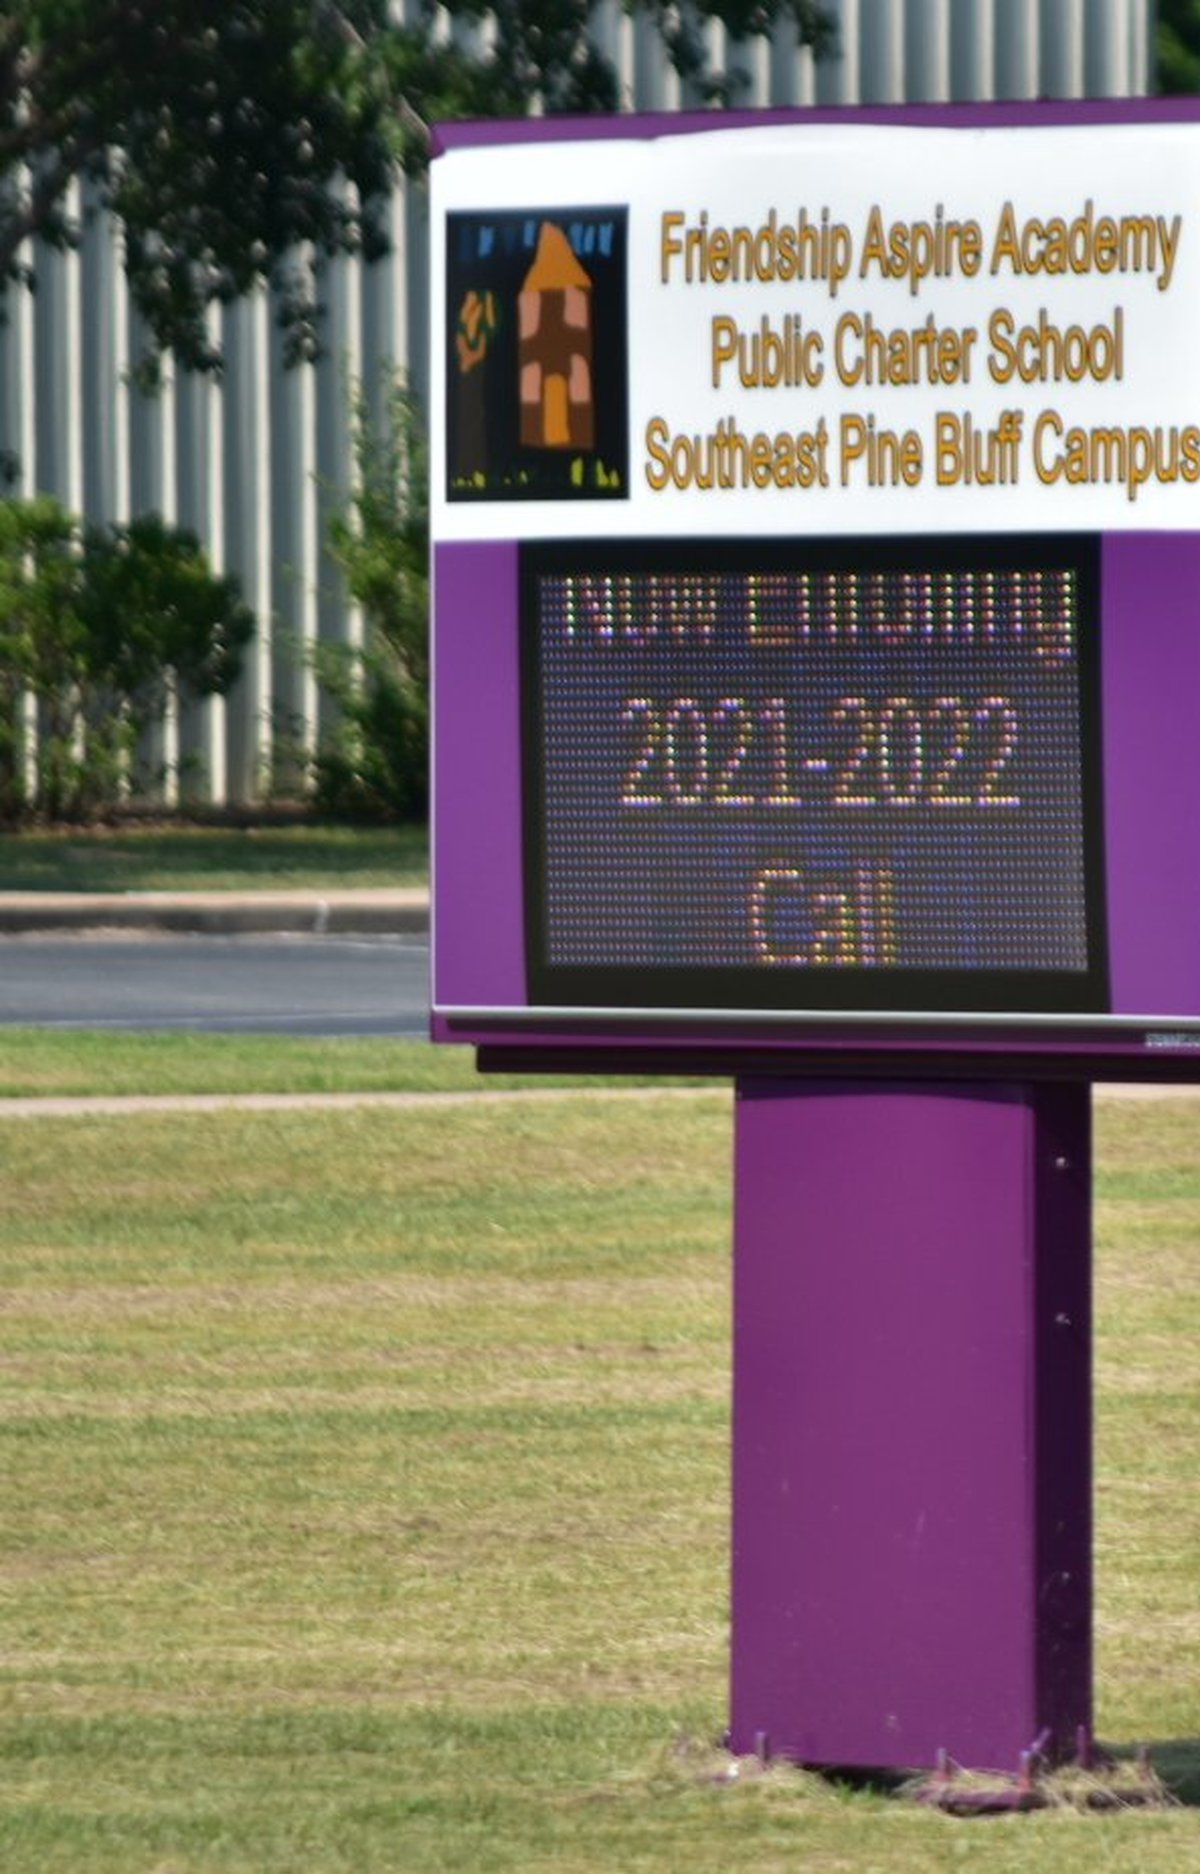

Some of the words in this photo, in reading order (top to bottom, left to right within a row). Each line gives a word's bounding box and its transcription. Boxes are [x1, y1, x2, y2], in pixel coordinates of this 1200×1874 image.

[661, 208, 851, 299] Friendship
[859, 205, 983, 297] Aspire
[990, 199, 1182, 292] Academy
[711, 313, 824, 390] Public
[834, 311, 977, 388] Charter
[987, 306, 1124, 386] School
[644, 415, 829, 492] Southeast
[839, 412, 923, 487] Pine
[935, 410, 1024, 487] Bluff
[620, 696, 1022, 809] 2021-2022
[750, 866, 897, 968] Call
